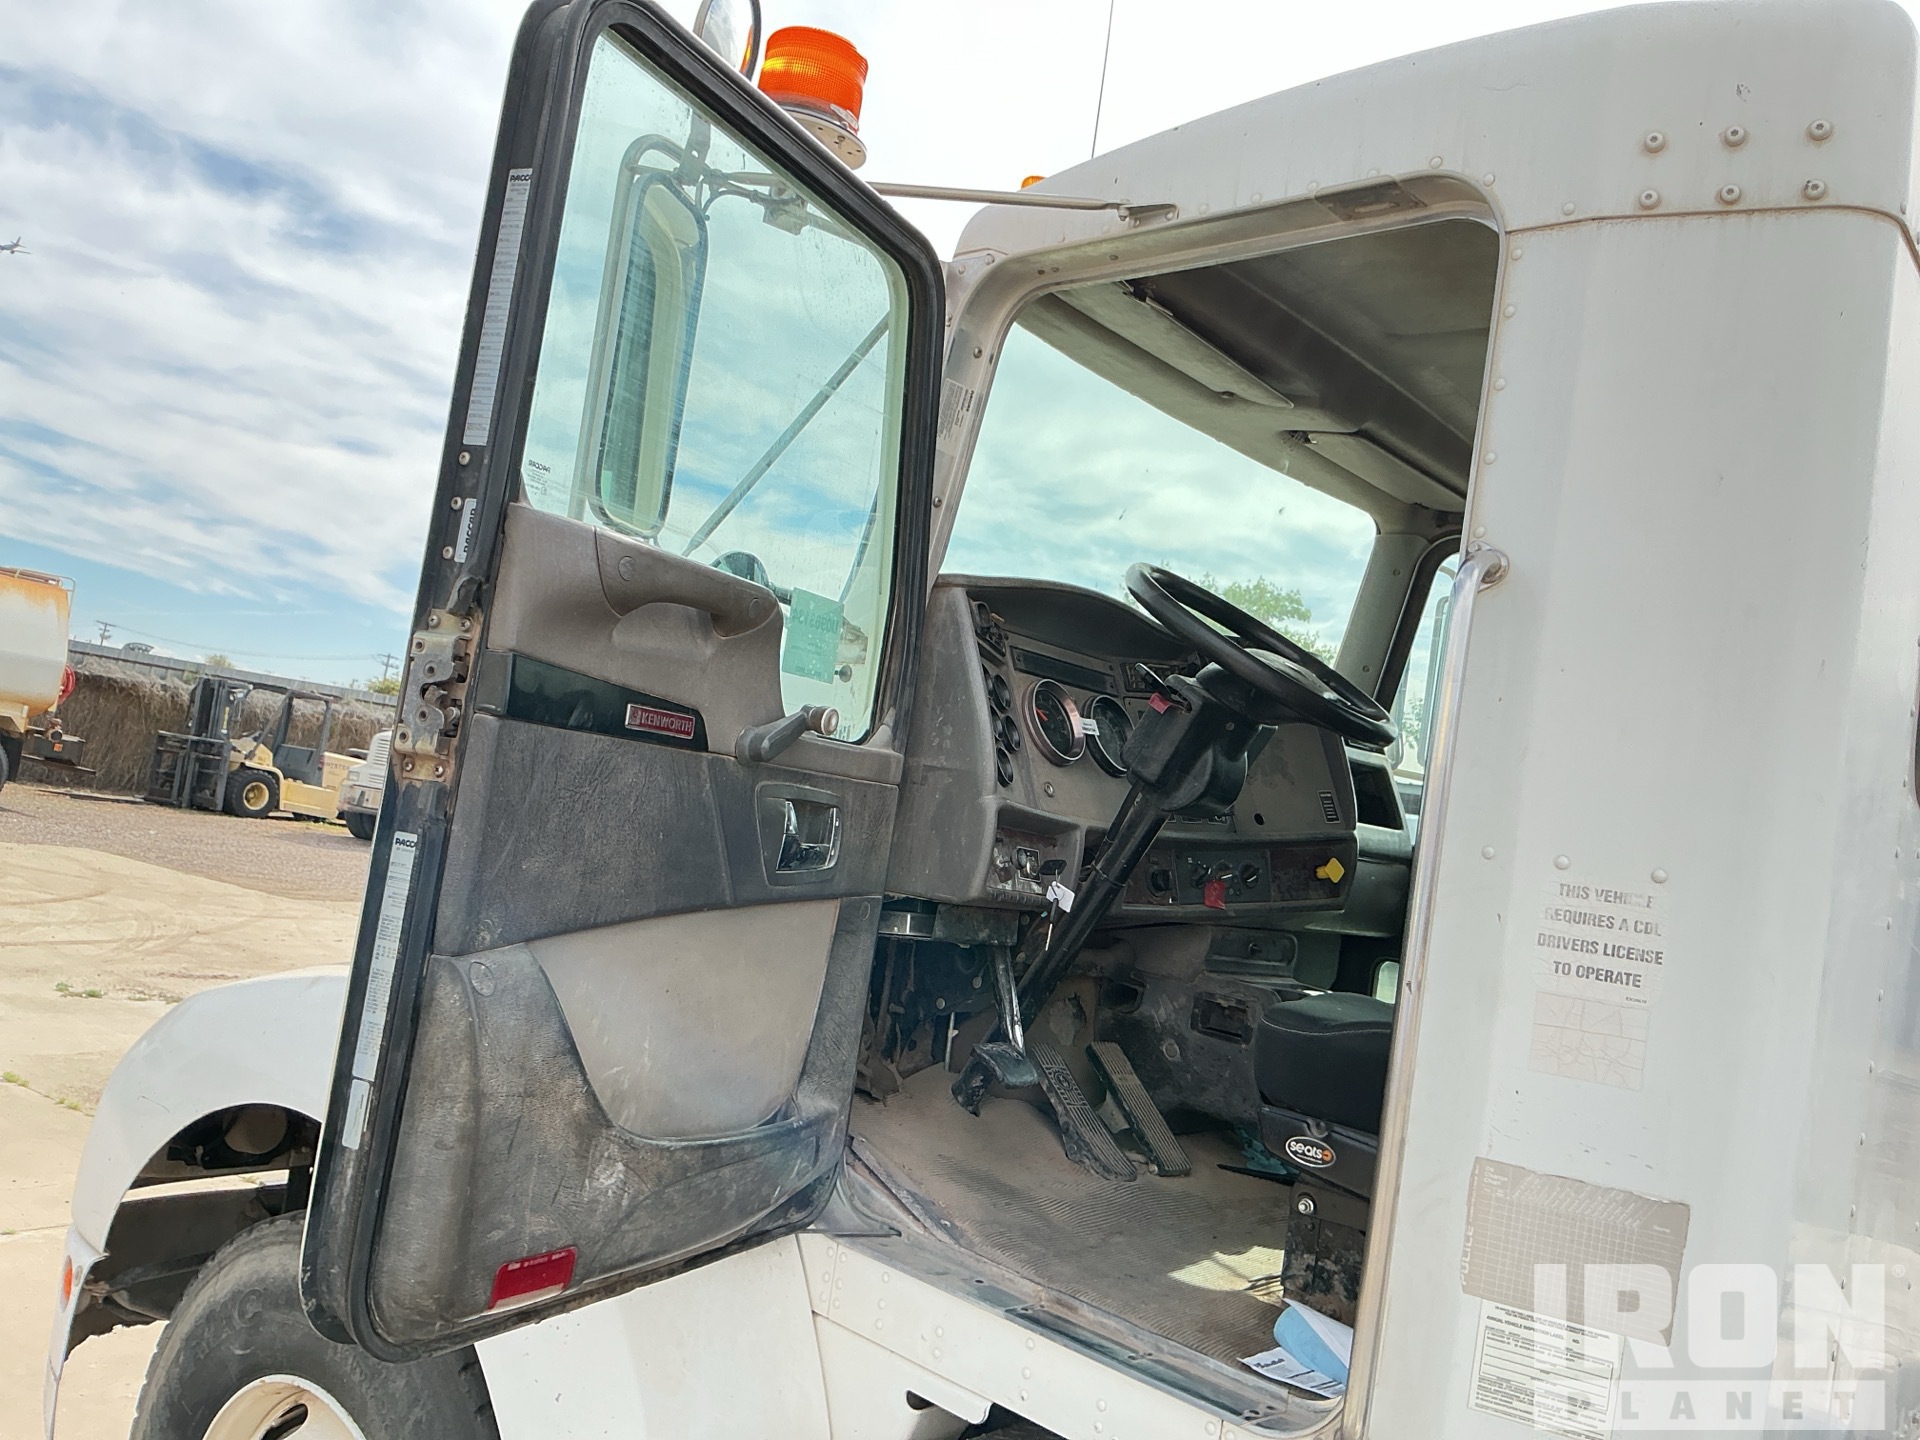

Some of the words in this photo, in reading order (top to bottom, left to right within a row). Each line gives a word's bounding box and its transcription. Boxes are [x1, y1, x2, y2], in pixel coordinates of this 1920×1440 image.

[640, 711, 693, 732] KENWORTH
[1558, 883, 1590, 900] THIS
[1544, 907, 1615, 930] REQUIRES
[1618, 918, 1630, 932] A
[1633, 919, 1662, 937] CDL
[1536, 932, 1599, 955] DRIVERS
[1602, 943, 1664, 966] LICENSE
[1553, 960, 1571, 976] TO
[1575, 964, 1642, 989] OPERATE
[1289, 1141, 1323, 1159] seats
